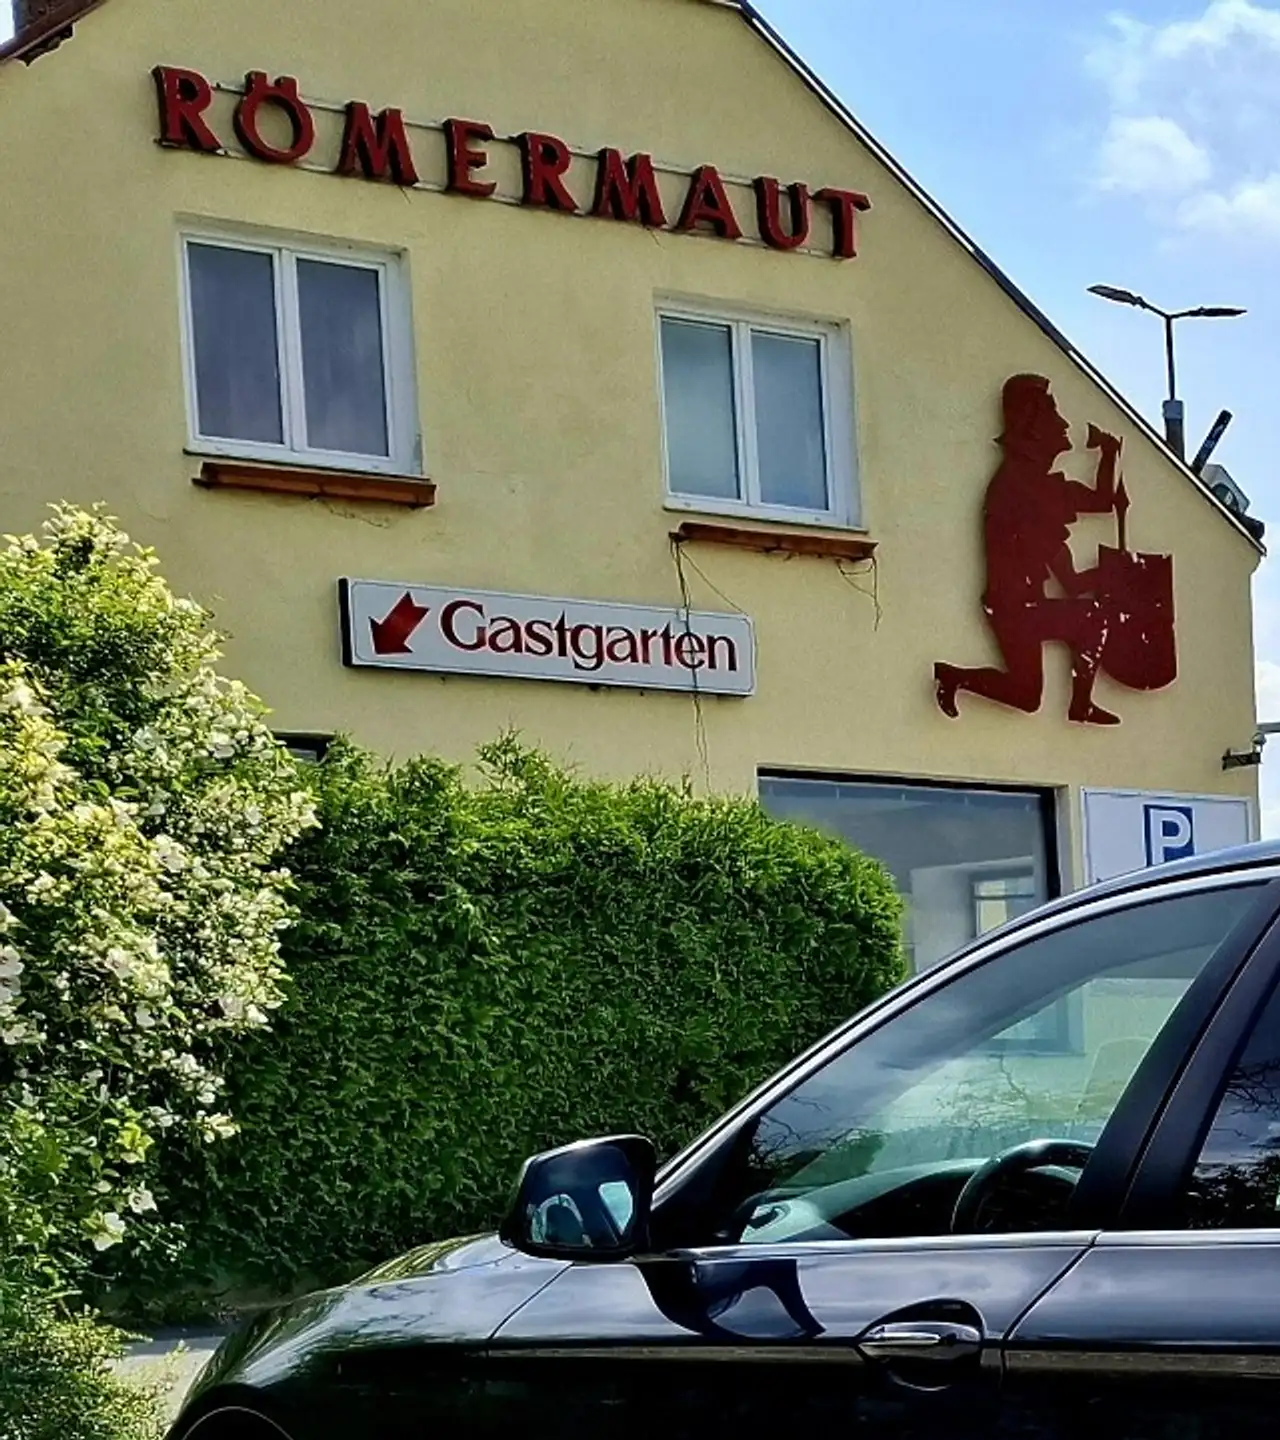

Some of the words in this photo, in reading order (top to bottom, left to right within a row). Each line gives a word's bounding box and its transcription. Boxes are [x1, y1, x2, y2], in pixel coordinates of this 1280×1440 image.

[151, 64, 871, 259] RÖMERMAUT
[439, 600, 737, 672] Gastgarten
[1149, 808, 1191, 865] P
